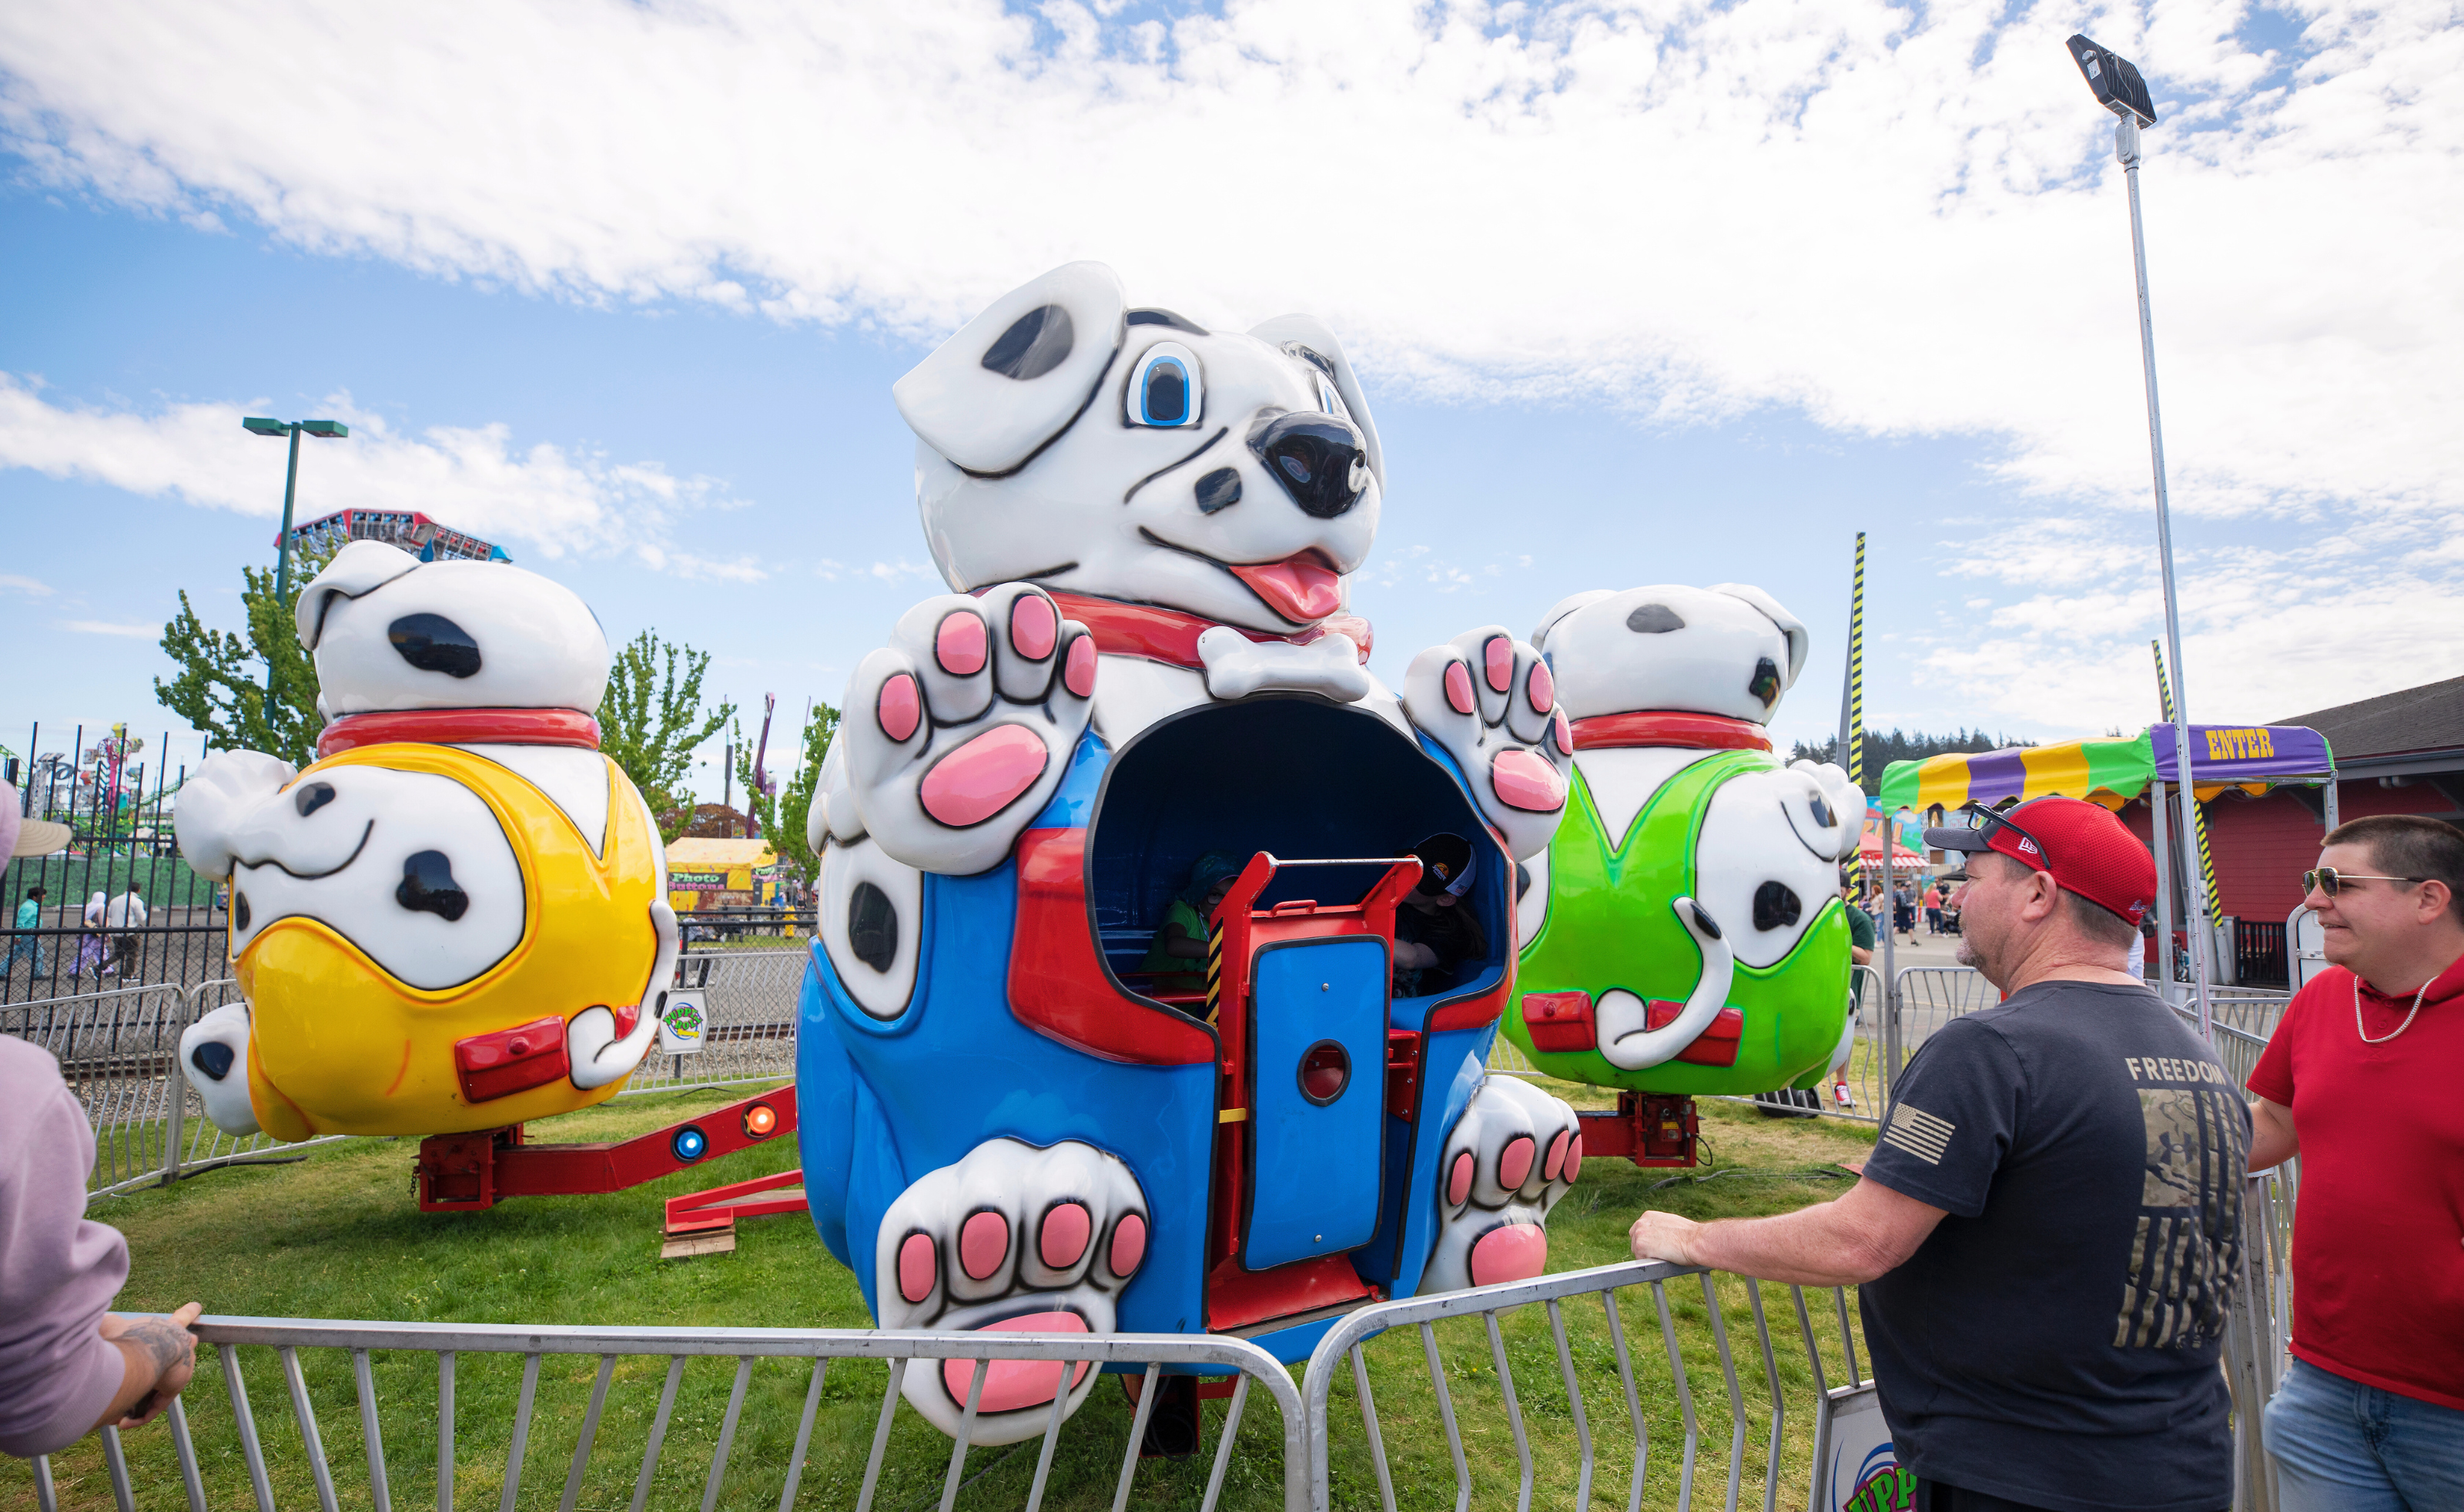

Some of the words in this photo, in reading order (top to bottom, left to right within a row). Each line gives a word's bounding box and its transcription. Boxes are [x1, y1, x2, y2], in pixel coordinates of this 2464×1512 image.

[2205, 728, 2275, 760] ENTER
[668, 881, 725, 890] Buttons
[672, 873, 720, 883] Photo
[663, 1007, 698, 1026] PUPPY
[674, 1015, 703, 1031] ROLL
[2124, 1057, 2227, 1086] FREEDOM
